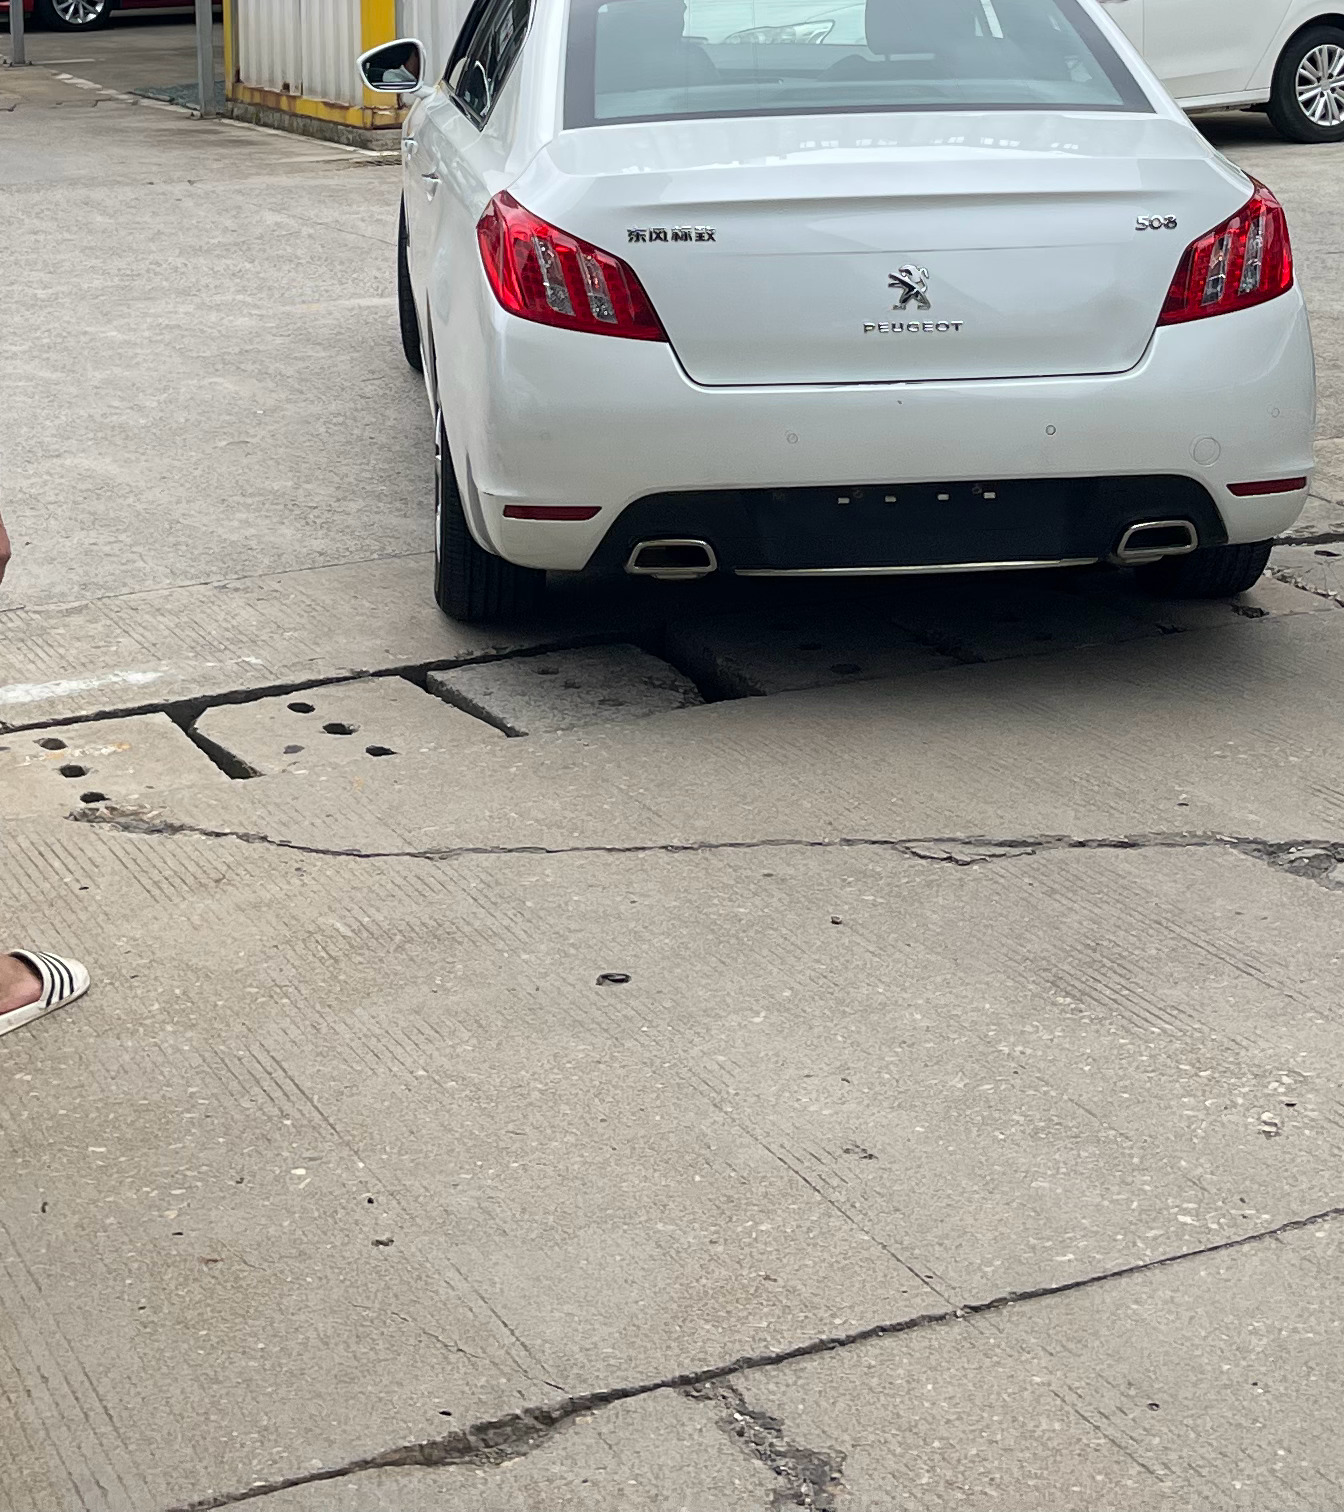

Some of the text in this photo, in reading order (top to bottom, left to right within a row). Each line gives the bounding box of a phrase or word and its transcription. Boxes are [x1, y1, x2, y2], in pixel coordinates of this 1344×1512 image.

[1135, 214, 1177, 231] 508
[627, 225, 716, 243] 东风标致
[863, 320, 963, 334] PEUGEOT
